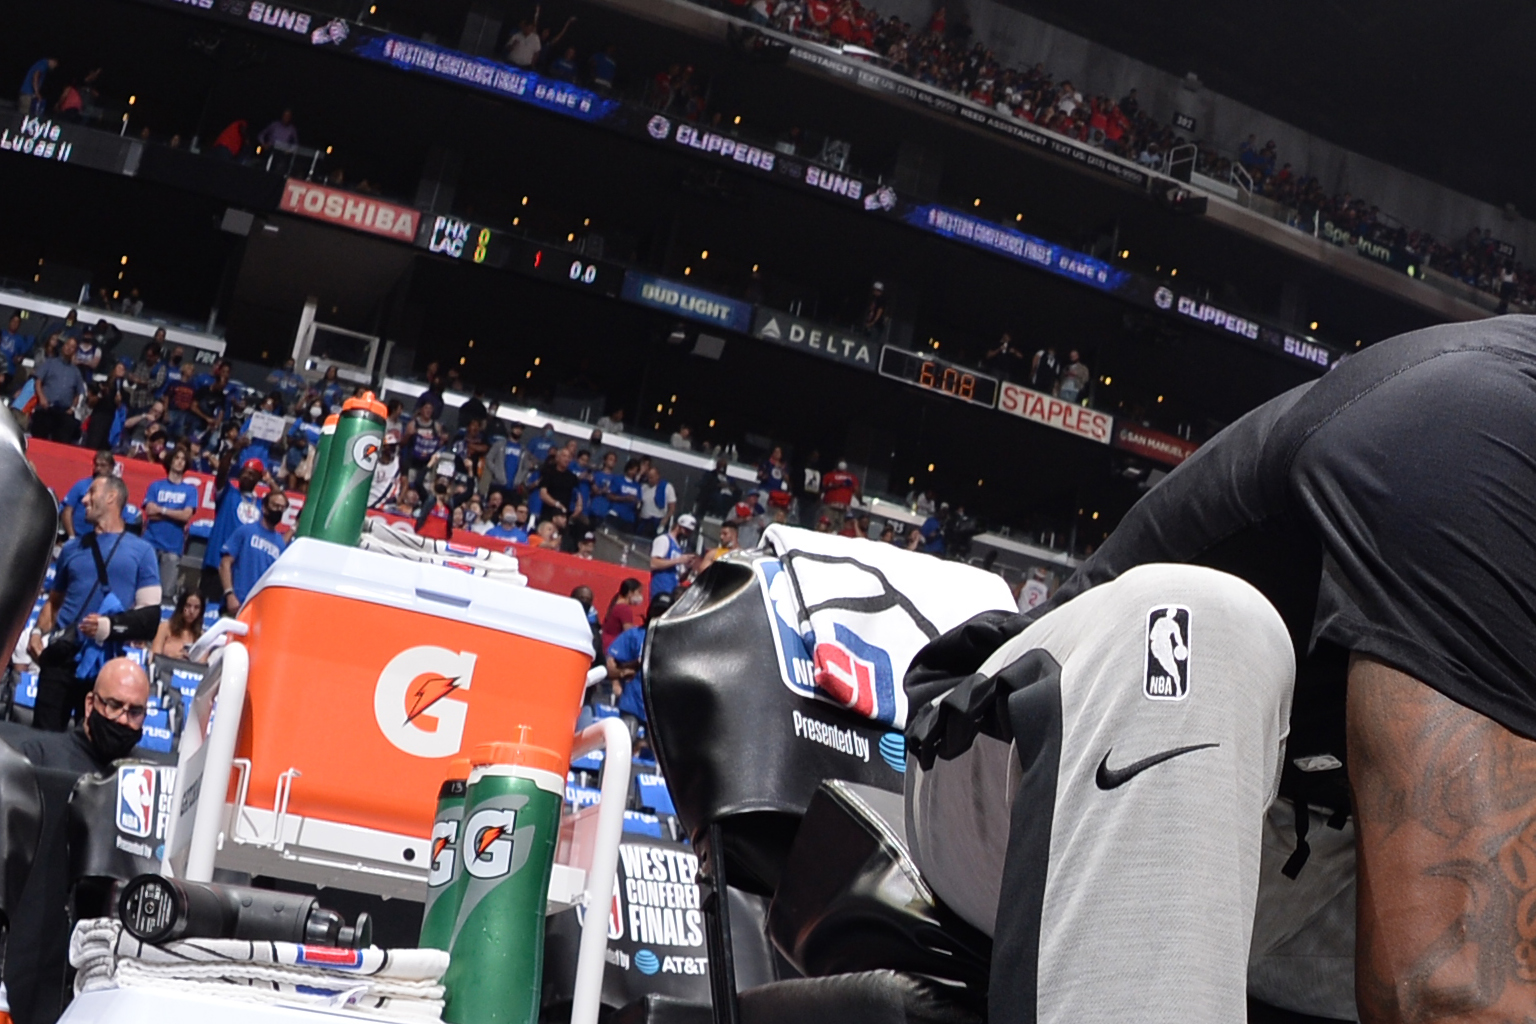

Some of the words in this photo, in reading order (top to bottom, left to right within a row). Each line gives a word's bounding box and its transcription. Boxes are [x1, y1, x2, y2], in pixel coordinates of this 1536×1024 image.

[248, 1, 312, 35] SUNS
[21, 114, 61, 141] Kyle
[960, 107, 986, 125] NEED
[676, 124, 776, 172] CLIPPERS
[805, 165, 863, 201] SUNS
[288, 183, 415, 237] TOSHIBA
[435, 215, 471, 240] PHX
[429, 230, 464, 258] LAC
[1323, 219, 1392, 262] Spetrum
[569, 259, 598, 285] 0.0
[641, 283, 681, 307] BUD
[679, 294, 730, 321] LIGHT
[789, 324, 871, 364] DELTA
[1178, 296, 1260, 341] CLIPPERS
[1283, 336, 1330, 367] SUNS
[918, 360, 977, 401] 6:08
[1000, 385, 1108, 442] STAPLES
[1127, 431, 1147, 447] SAN
[1146, 436, 1185, 459] MANUEL
[374, 644, 478, 759] G
[1149, 675, 1173, 696] NBA
[792, 710, 853, 757] Presented
[853, 731, 870, 763] by
[427, 819, 460, 888] G
[463, 807, 517, 880] G
[619, 844, 699, 884] WESTER
[625, 877, 700, 909] CONFERE
[628, 903, 703, 947] FINALS
[661, 955, 708, 975] AT&T
